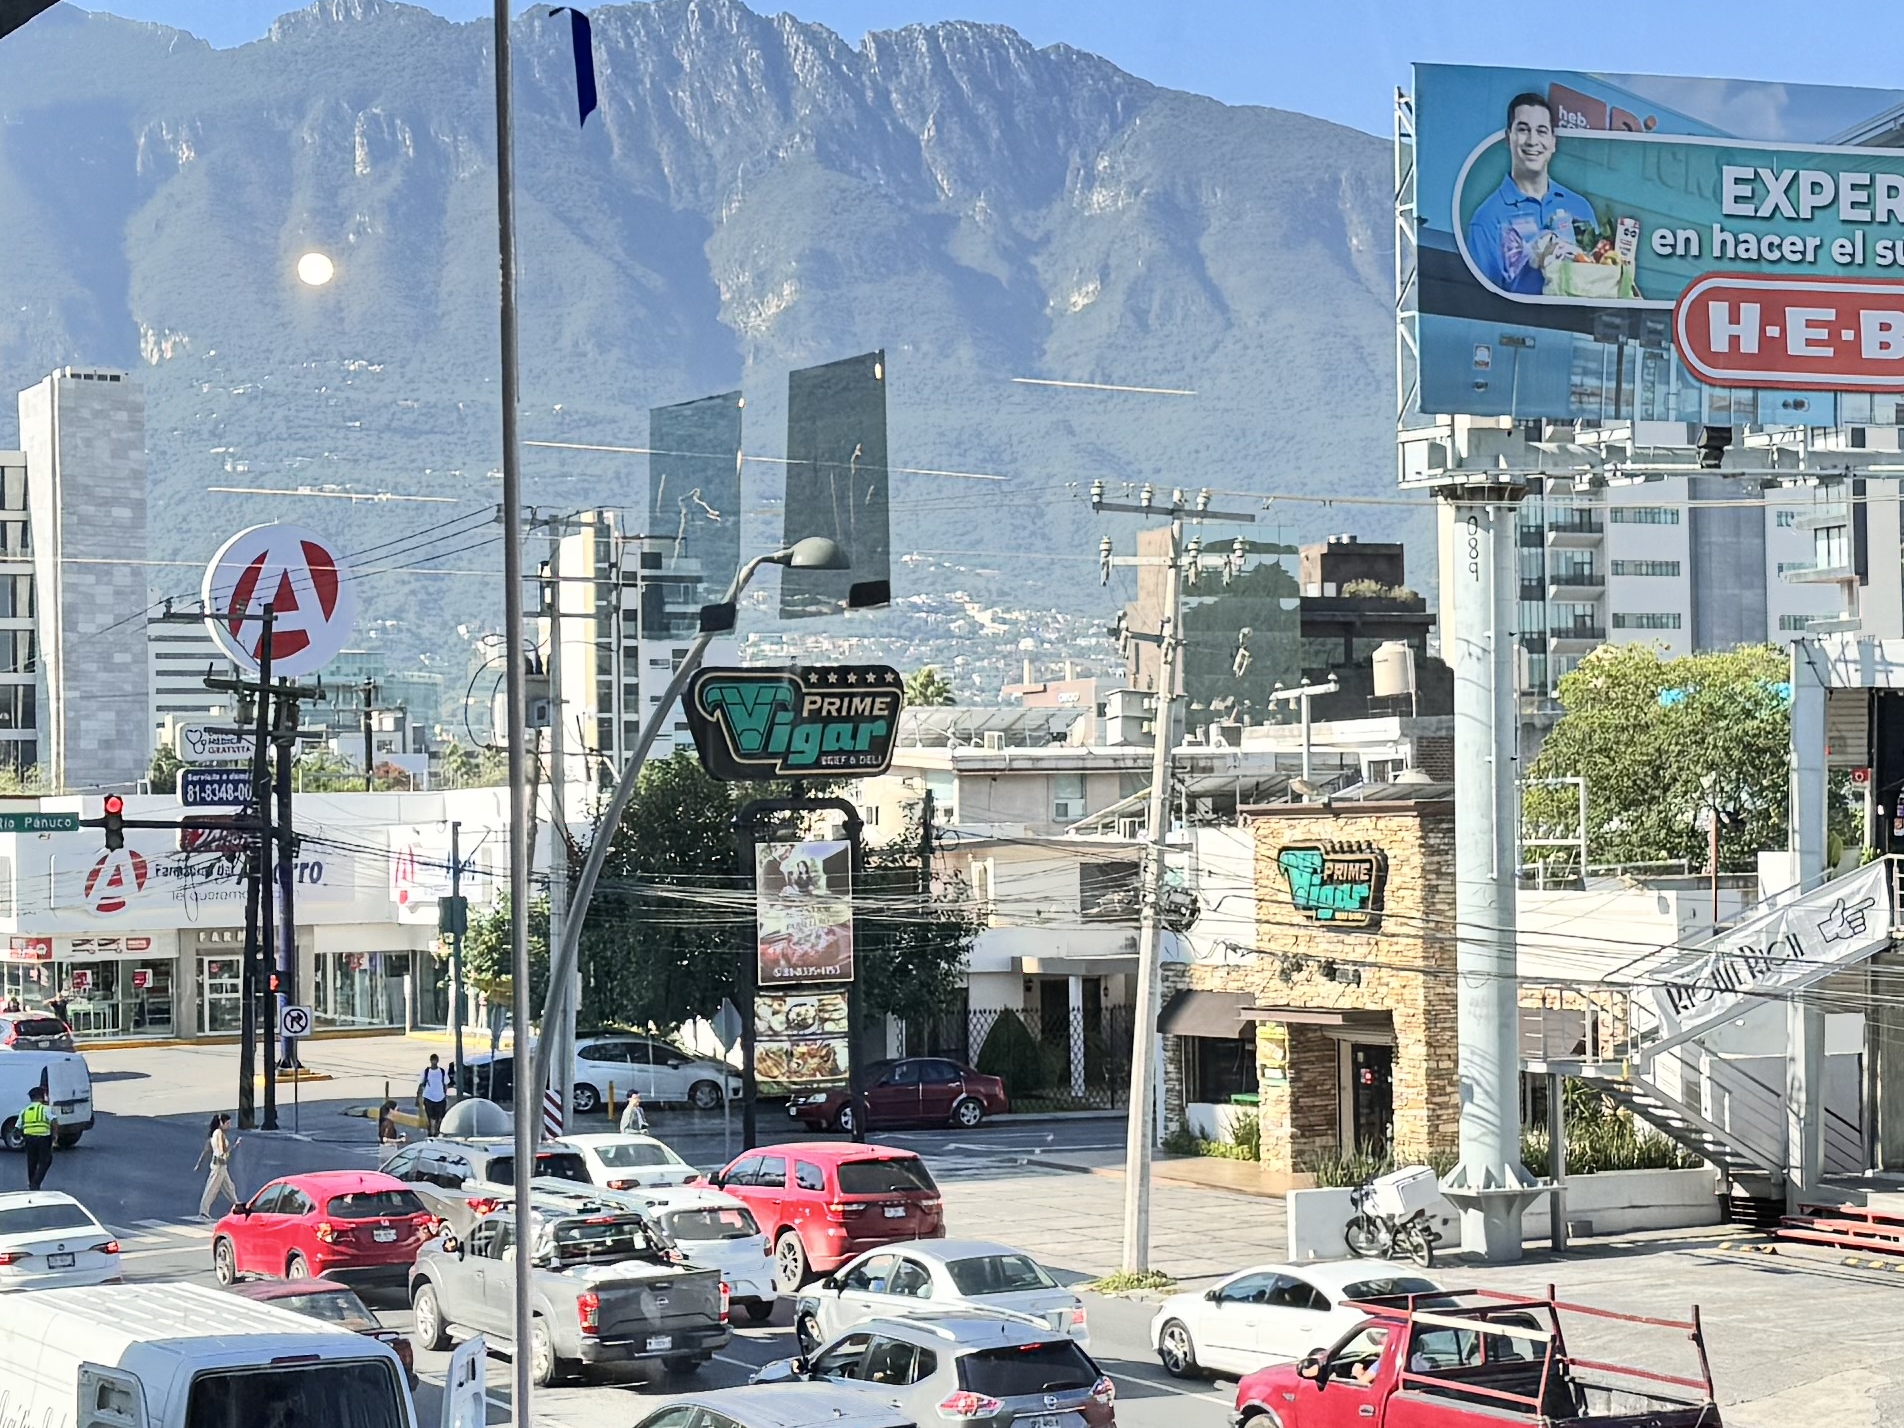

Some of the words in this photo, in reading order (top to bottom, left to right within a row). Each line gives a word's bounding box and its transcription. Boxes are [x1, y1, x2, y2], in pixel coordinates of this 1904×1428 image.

[1651, 227, 1699, 256] en
[1712, 223, 1821, 263] hacer
[1831, 229, 1864, 264] el
[802, 695, 891, 717] PRIME
[703, 683, 887, 765] Vigar
[24, 816, 72, 828] Pánuco
[1323, 861, 1370, 881] PRIME
